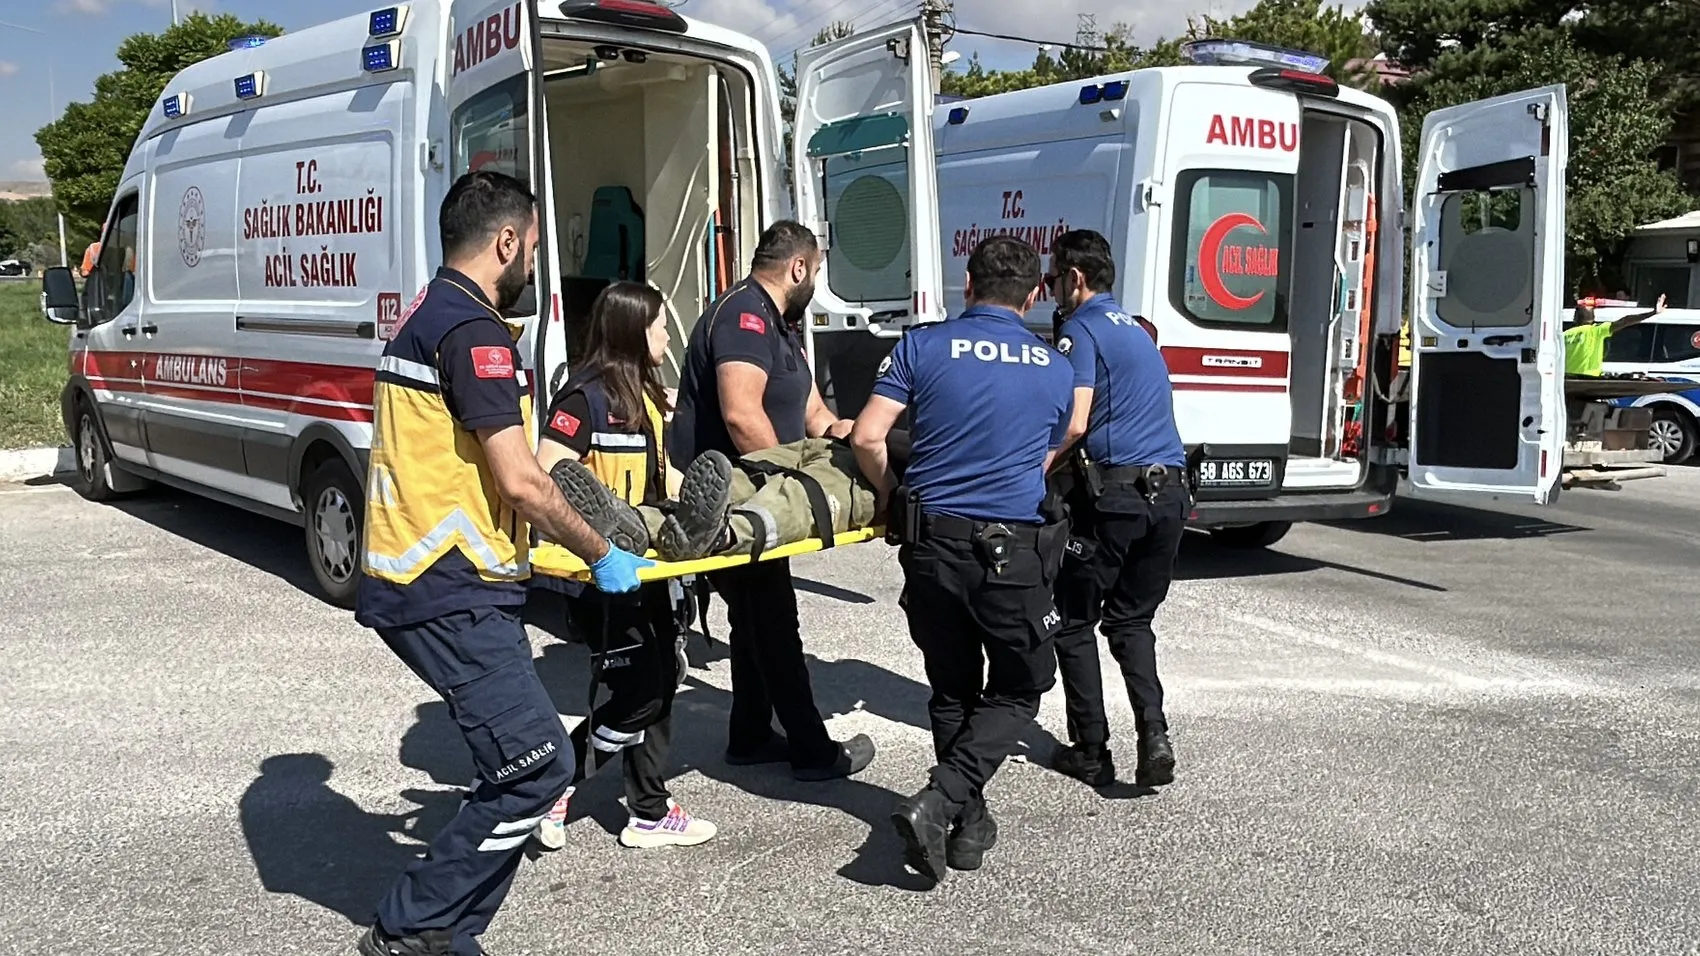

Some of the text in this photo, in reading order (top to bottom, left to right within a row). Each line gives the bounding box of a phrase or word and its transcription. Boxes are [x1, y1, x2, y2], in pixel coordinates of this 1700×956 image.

[454, 1, 521, 77] AMBU
[1206, 114, 1298, 152] AMBU
[296, 159, 322, 194] T.C.
[244, 187, 382, 239] SAĞLIK BAKANLIĞI
[1001, 190, 1025, 219] T.C.
[265, 245, 357, 287] ACİL SAĞLIK
[381, 298, 398, 321] 112
[156, 355, 227, 386] AMBULANS
[1200, 461, 1270, 480] 58 AGS 673
